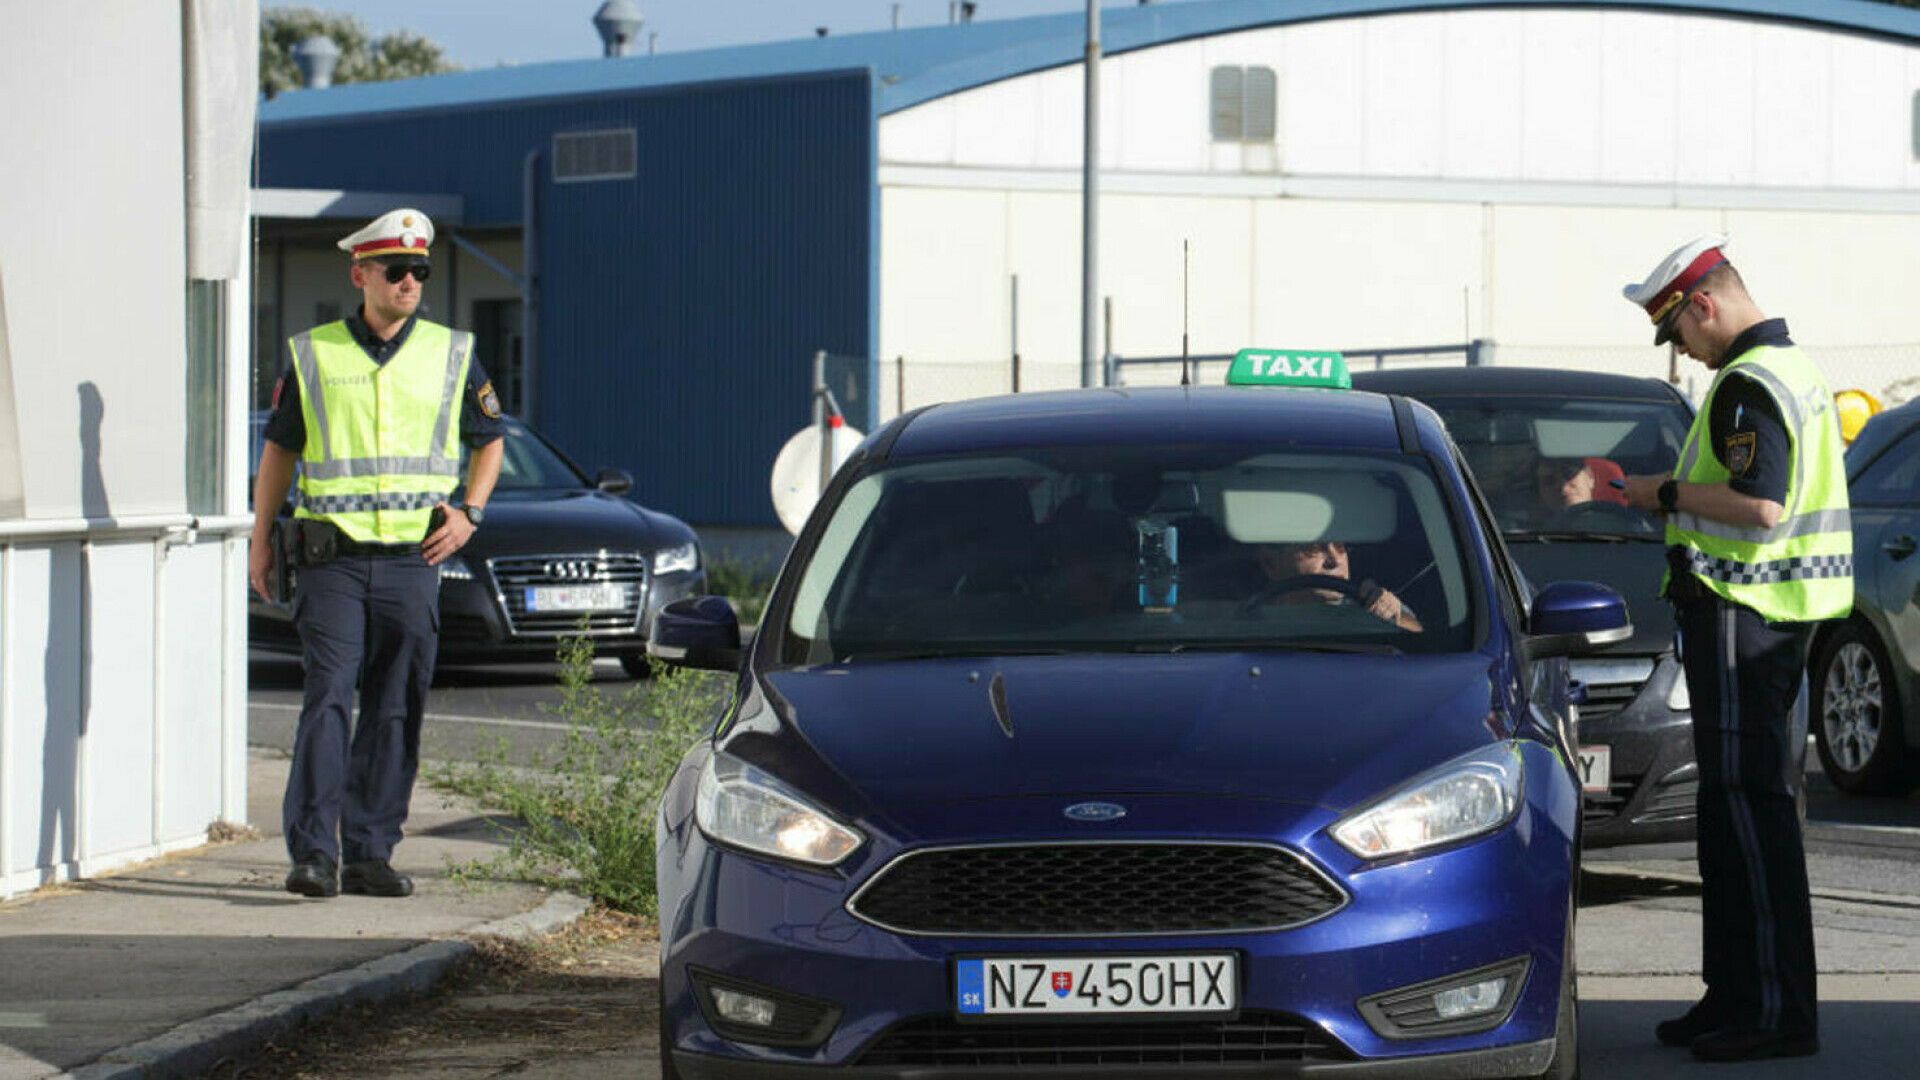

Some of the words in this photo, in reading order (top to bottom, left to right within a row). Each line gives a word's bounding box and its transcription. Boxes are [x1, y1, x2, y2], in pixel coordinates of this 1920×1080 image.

[1247, 354, 1332, 379] TAXI
[990, 964, 1047, 1008] NZ
[1077, 961, 1226, 1007] 450HX
[962, 992, 980, 1006] SK
